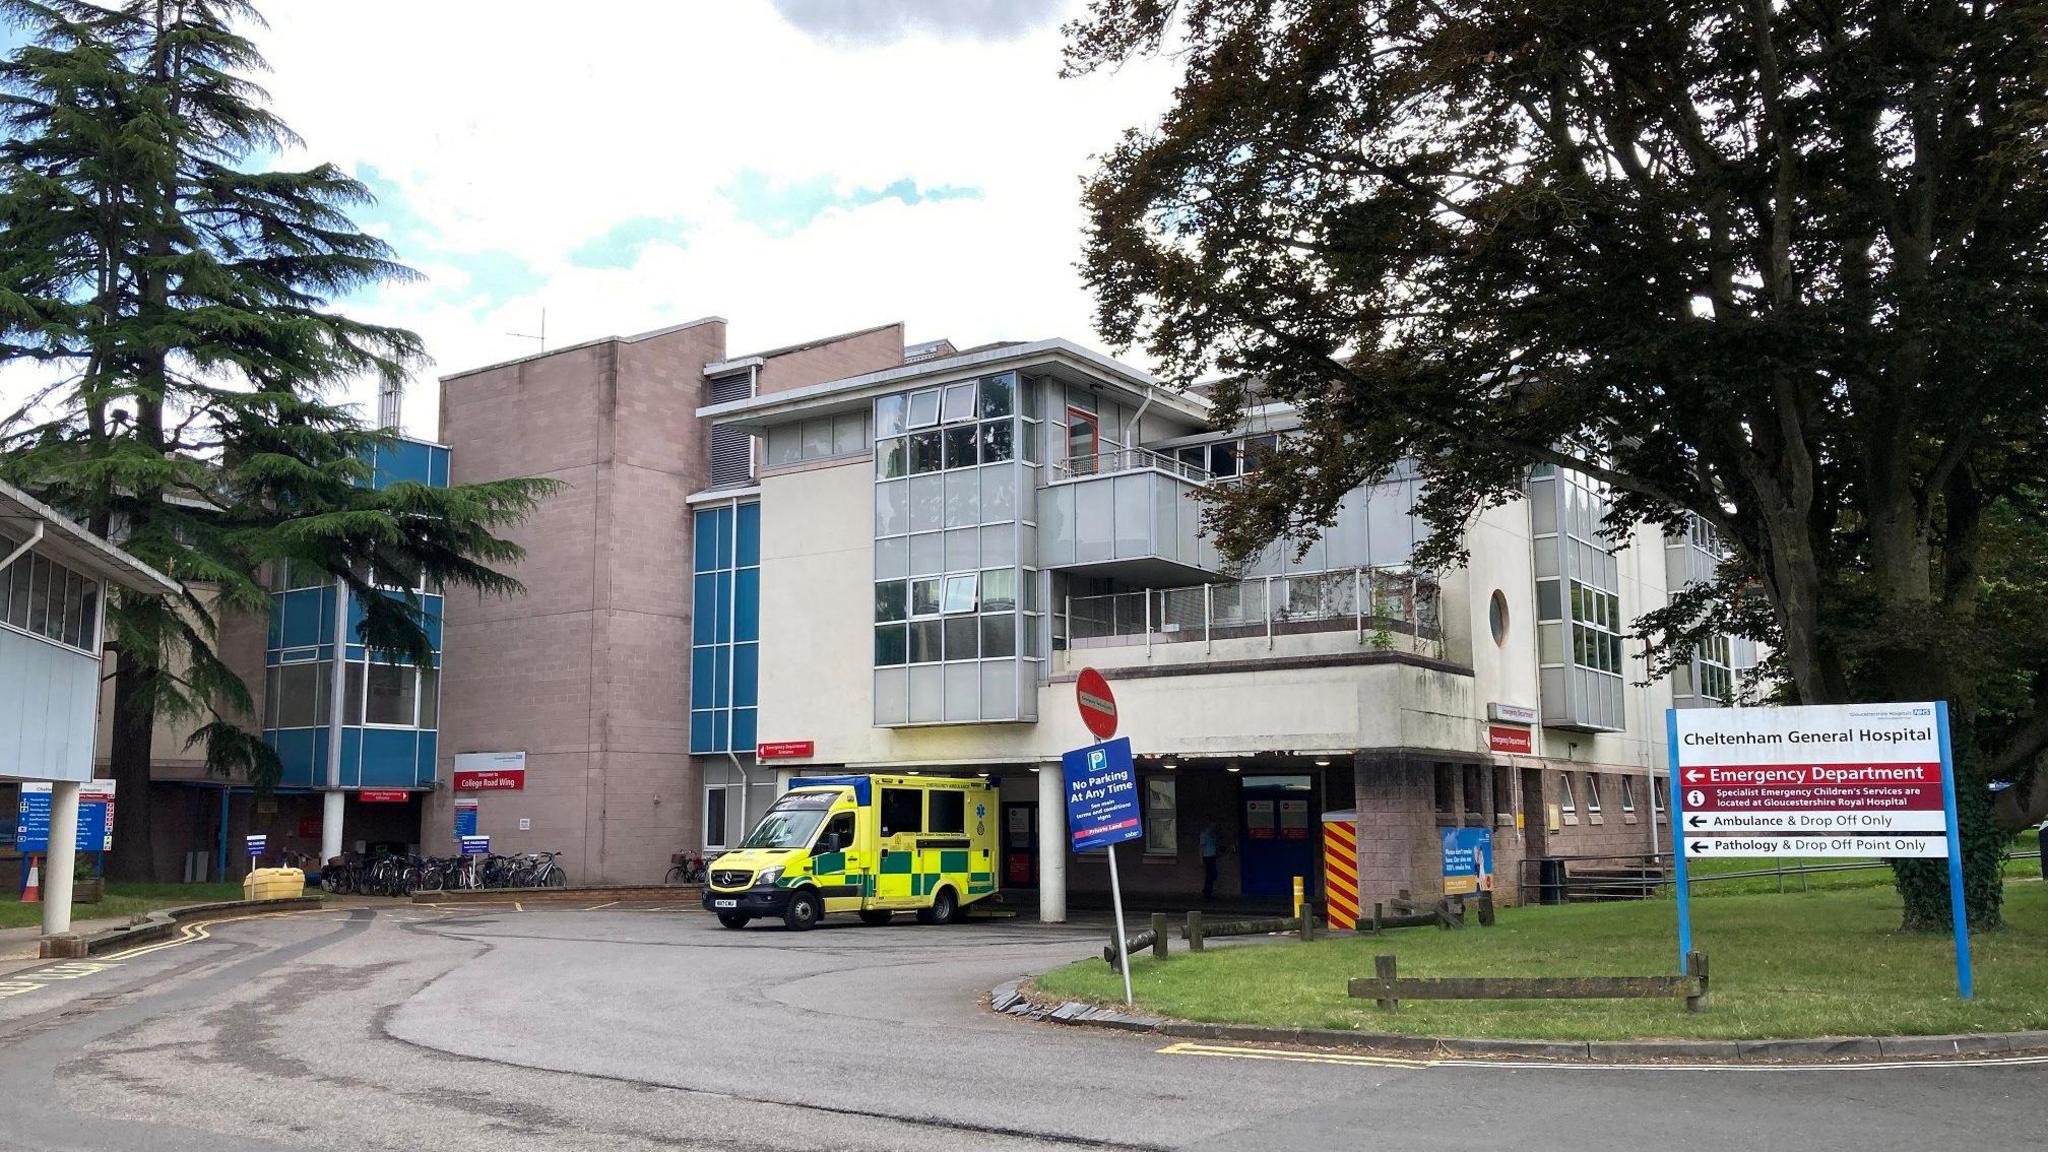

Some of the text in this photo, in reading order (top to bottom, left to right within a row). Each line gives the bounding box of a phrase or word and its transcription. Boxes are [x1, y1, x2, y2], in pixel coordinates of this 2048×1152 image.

[1912, 708, 1931, 716] NHS
[1491, 735, 1526, 746] Emergency Department
[1684, 727, 1932, 746] Cheltenham General Hospital
[1072, 770, 1129, 791] No Parking
[1710, 765, 1925, 784] Emergency Department
[461, 777, 515, 789] College Road Wing
[1070, 781, 1134, 804] At Any Time
[1716, 786, 1921, 798] Specialist Emergency Children's Services are
[1101, 799, 1116, 807] main
[1717, 796, 1908, 808] located at Gloucestershire Royal Hospital
[1076, 811, 1092, 819] terms
[1103, 802, 1132, 813] conditions
[1097, 813, 1111, 822] signs
[1713, 814, 1893, 828] Ambulance & Drop Off Only
[1088, 822, 1123, 835] Private Land
[1714, 838, 1926, 853] Pathology & Drop Off Point Only
